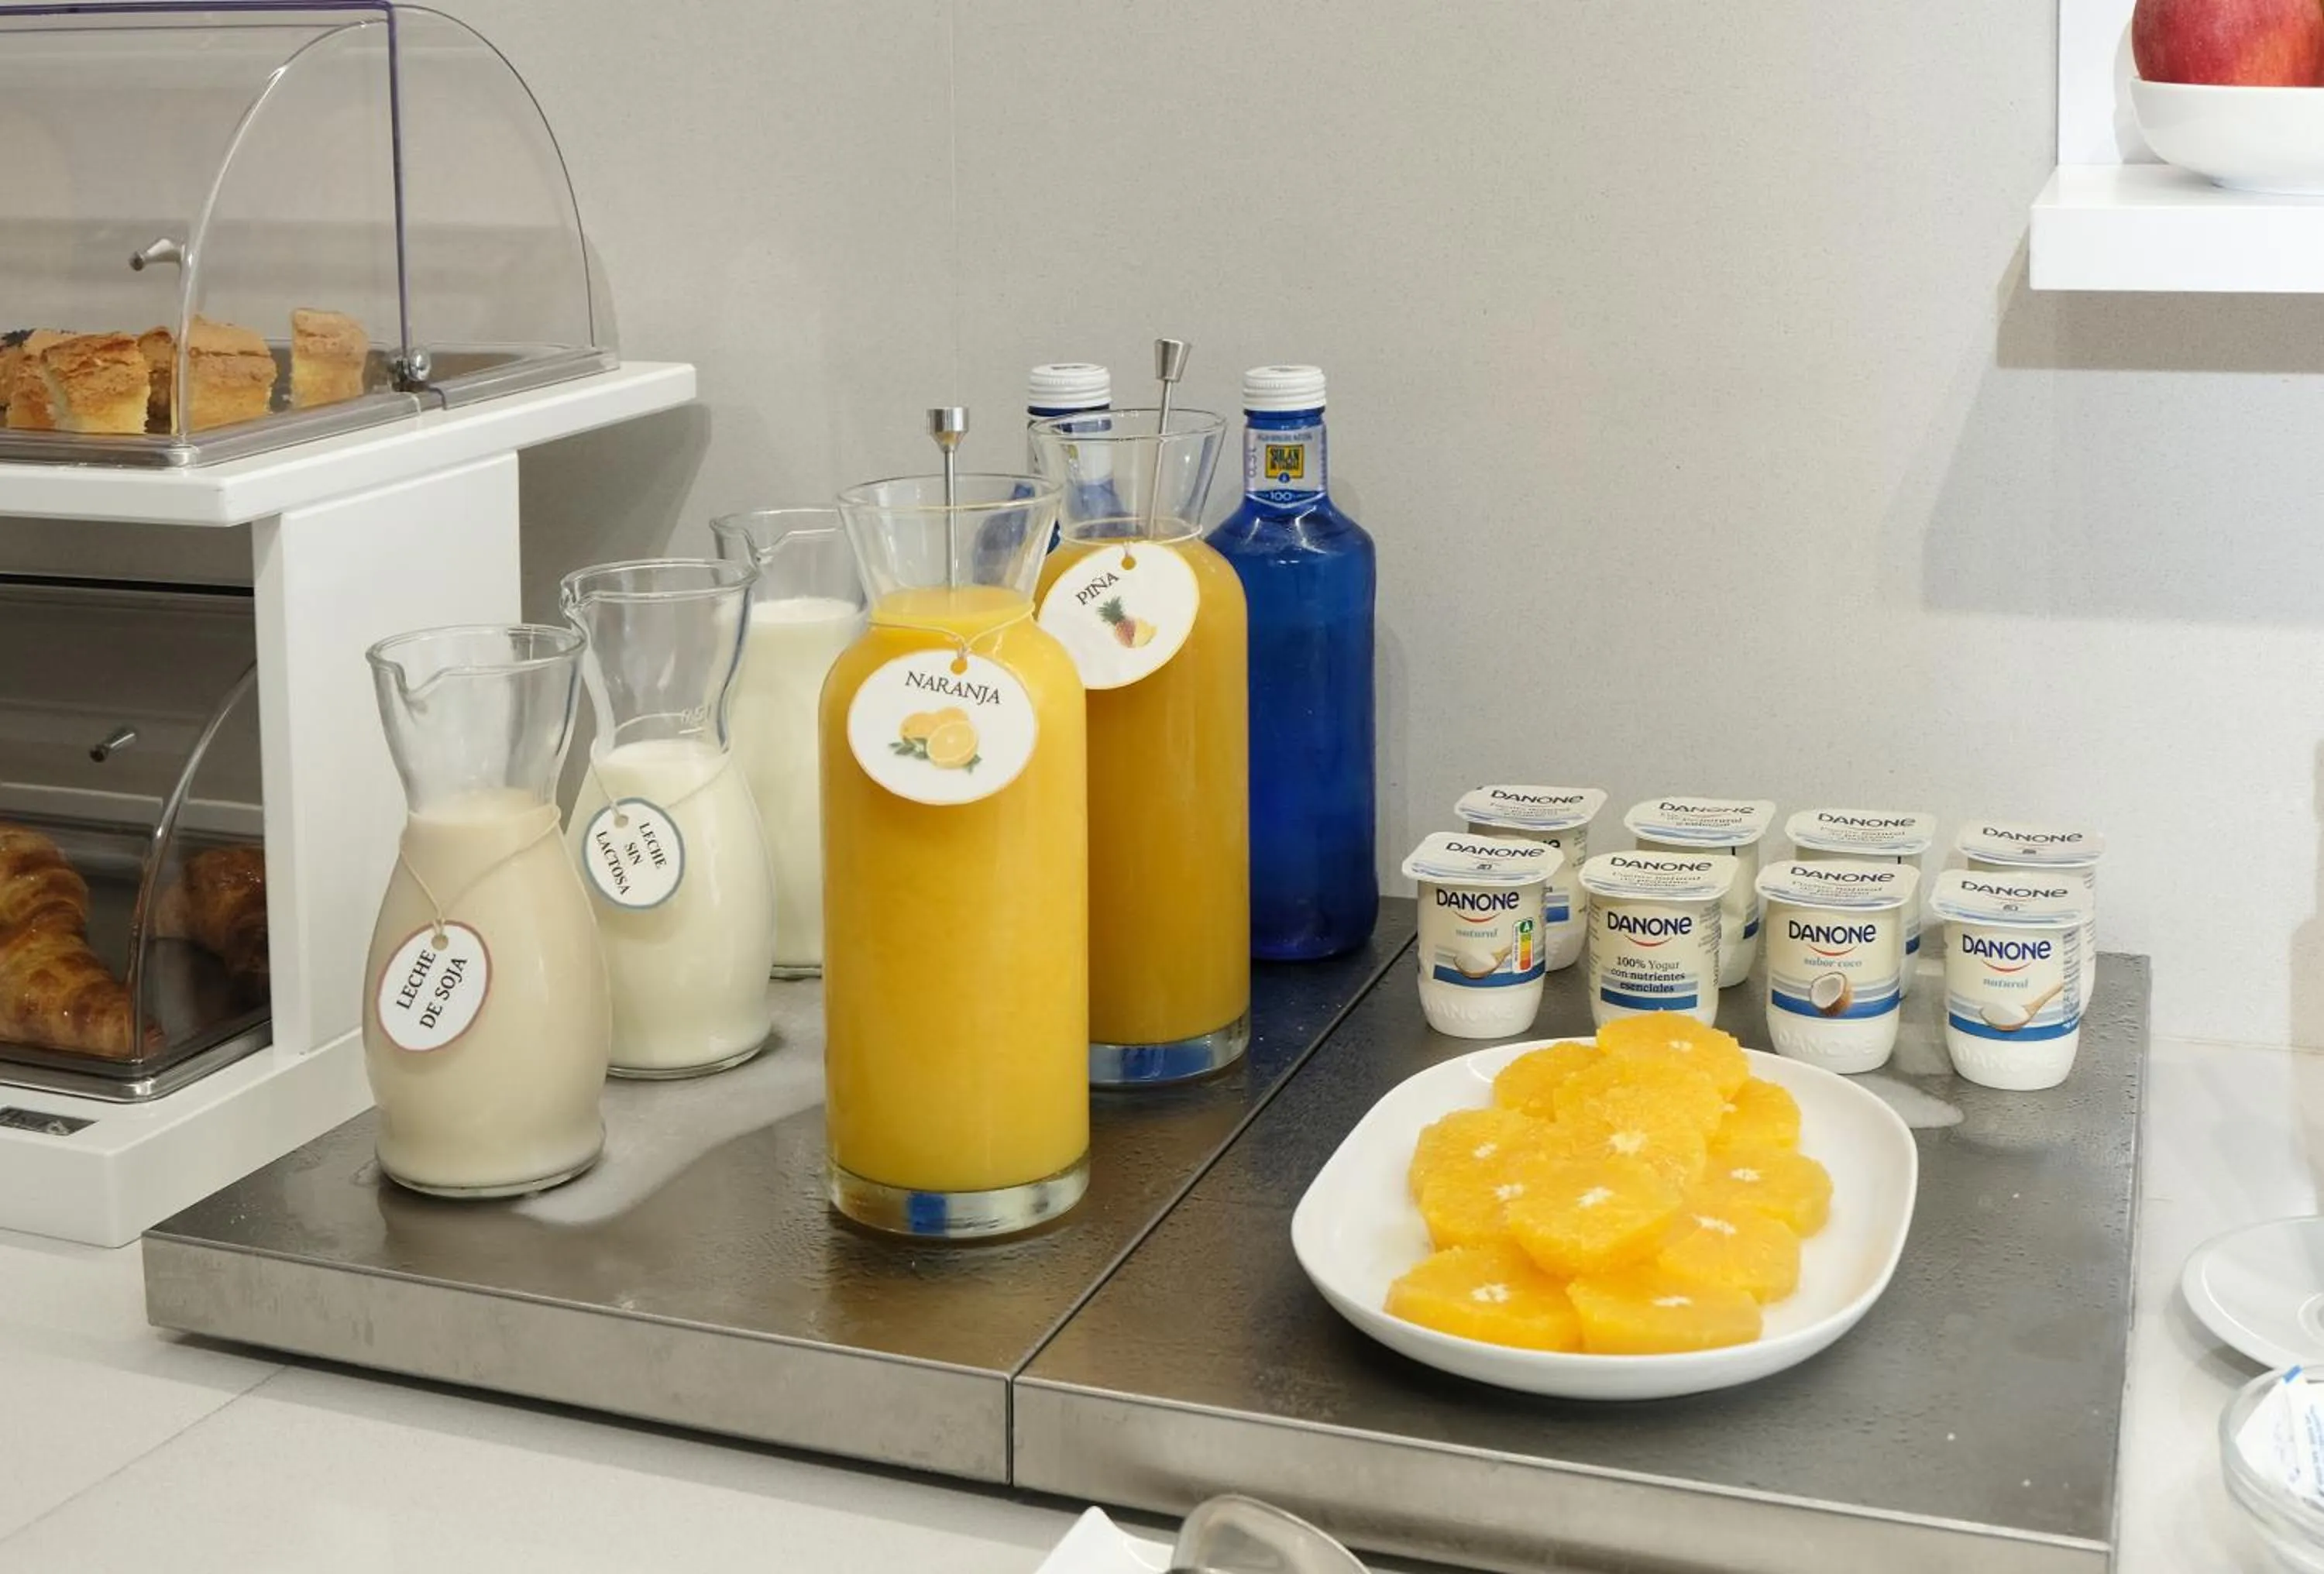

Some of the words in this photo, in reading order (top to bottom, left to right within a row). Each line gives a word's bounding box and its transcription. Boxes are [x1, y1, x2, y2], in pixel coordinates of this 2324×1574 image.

[1075, 572, 1119, 606] PIÑA
[905, 671, 1002, 706] NARANJA
[624, 842, 644, 866] SIN
[639, 822, 667, 869] LECHE
[596, 830, 631, 895] LACTOSA
[1456, 928, 1498, 937] natural
[1611, 967, 1628, 978] con
[1629, 970, 1686, 981] nutrientes
[1617, 956, 1645, 968] 100%
[396, 949, 436, 1009] LECHE
[420, 1002, 442, 1029] DE
[435, 957, 468, 1000] SOJA
[1620, 981, 1674, 993] esenciales
[1983, 978, 2029, 988] natural
